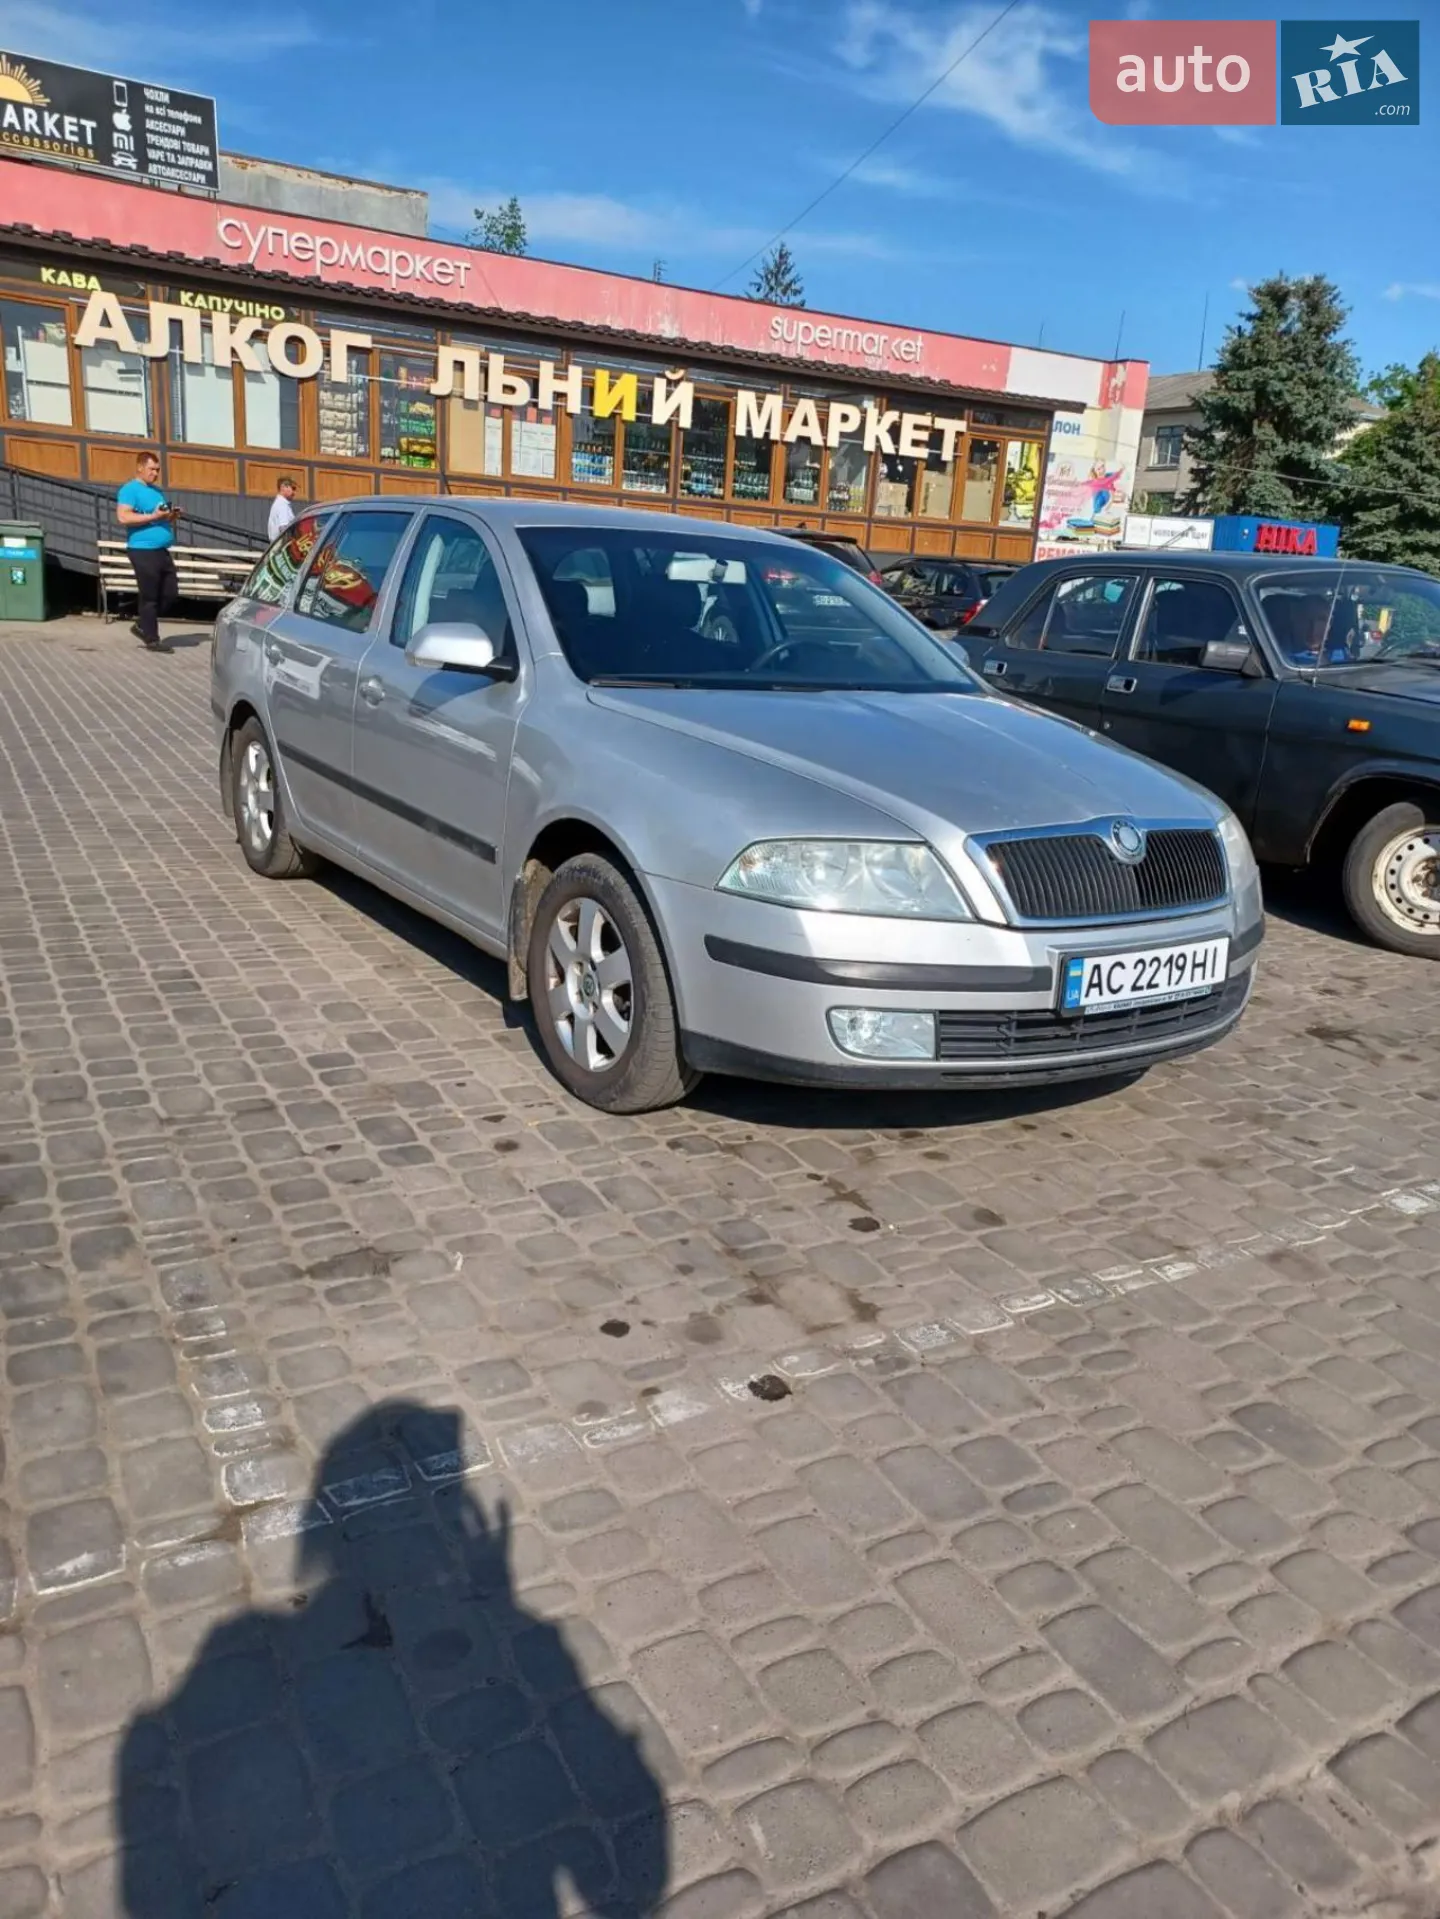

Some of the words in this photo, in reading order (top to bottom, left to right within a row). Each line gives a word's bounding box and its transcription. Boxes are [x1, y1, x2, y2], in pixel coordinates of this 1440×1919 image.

[2, 103, 98, 146] ARKET
[2, 131, 96, 159] ccessories
[216, 216, 473, 290] супермаркет
[40, 267, 102, 292] КАВА
[179, 290, 286, 322] КАПУЧІНО
[734, 390, 967, 462] МАРКЕТ
[1085, 961, 1126, 998] AC
[1131, 952, 1187, 992] 2219
[1190, 946, 1218, 983] HI
